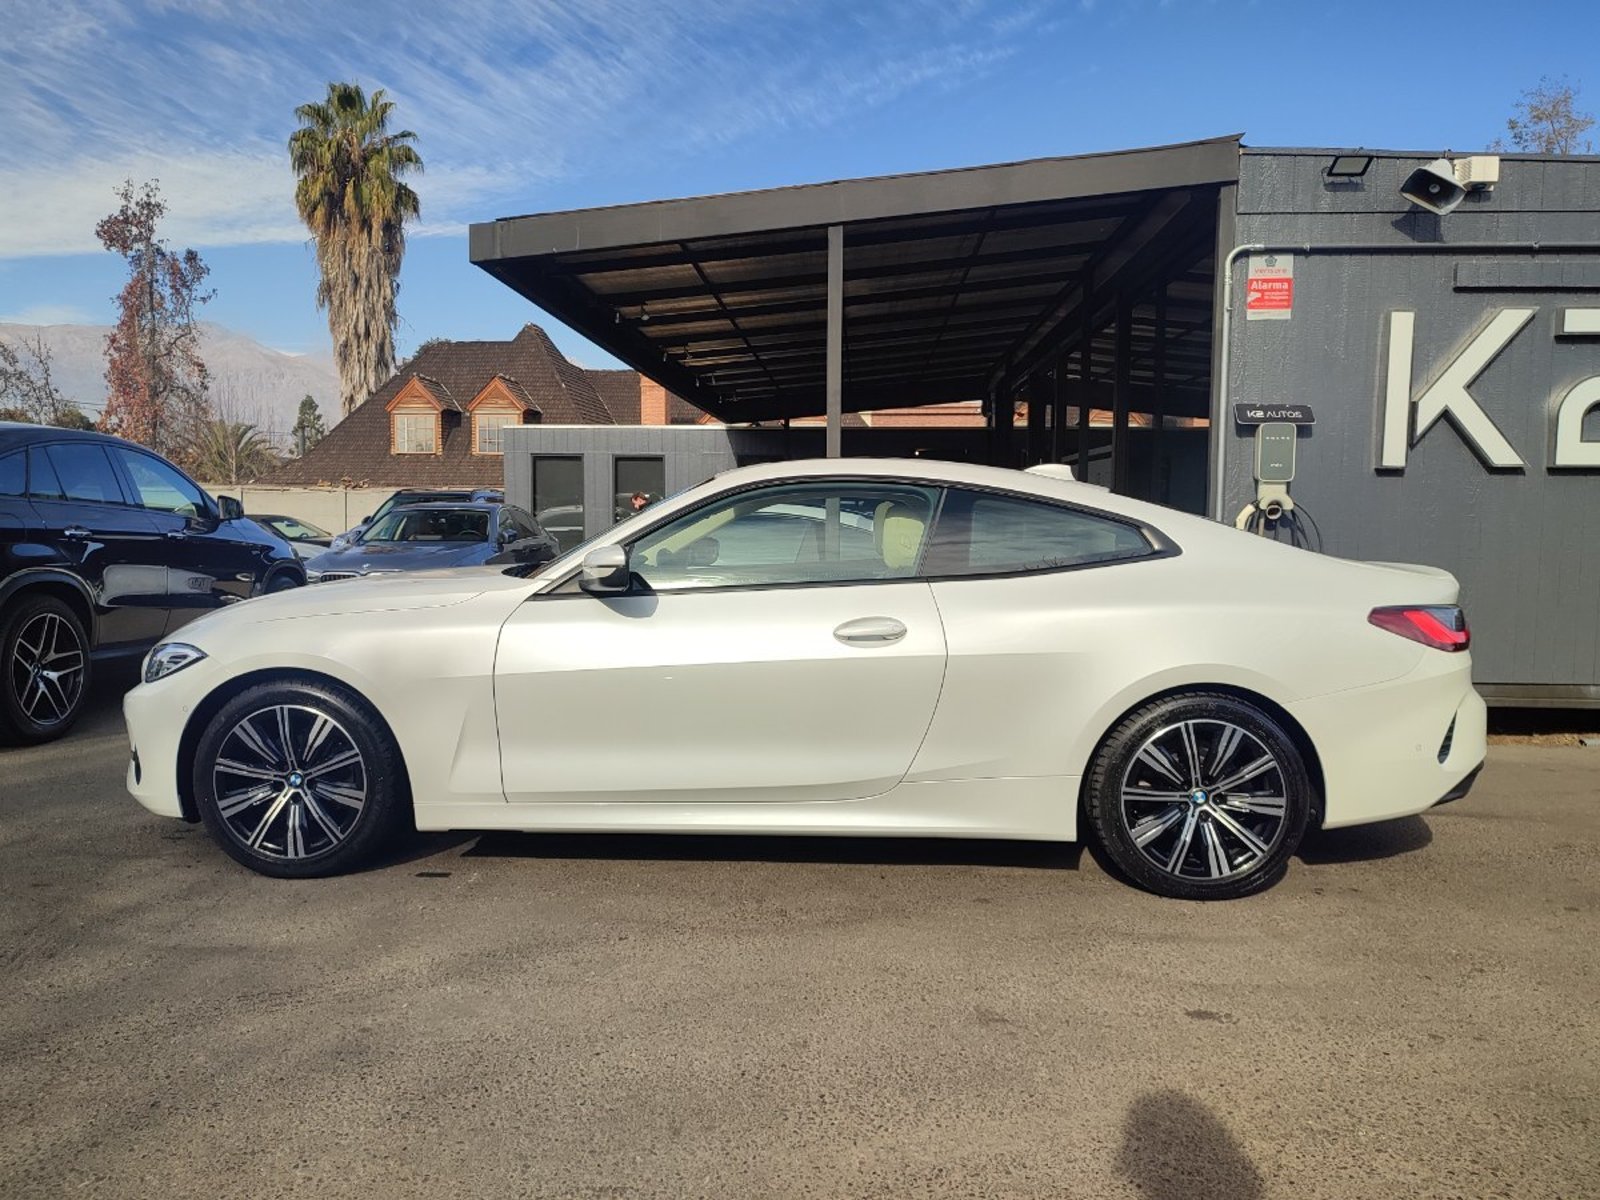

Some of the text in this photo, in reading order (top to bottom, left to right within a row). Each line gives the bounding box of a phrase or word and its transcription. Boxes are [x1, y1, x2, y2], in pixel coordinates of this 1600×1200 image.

[1250, 280, 1289, 290] Alarma
[1247, 410, 1303, 418] K2 AUTOS
